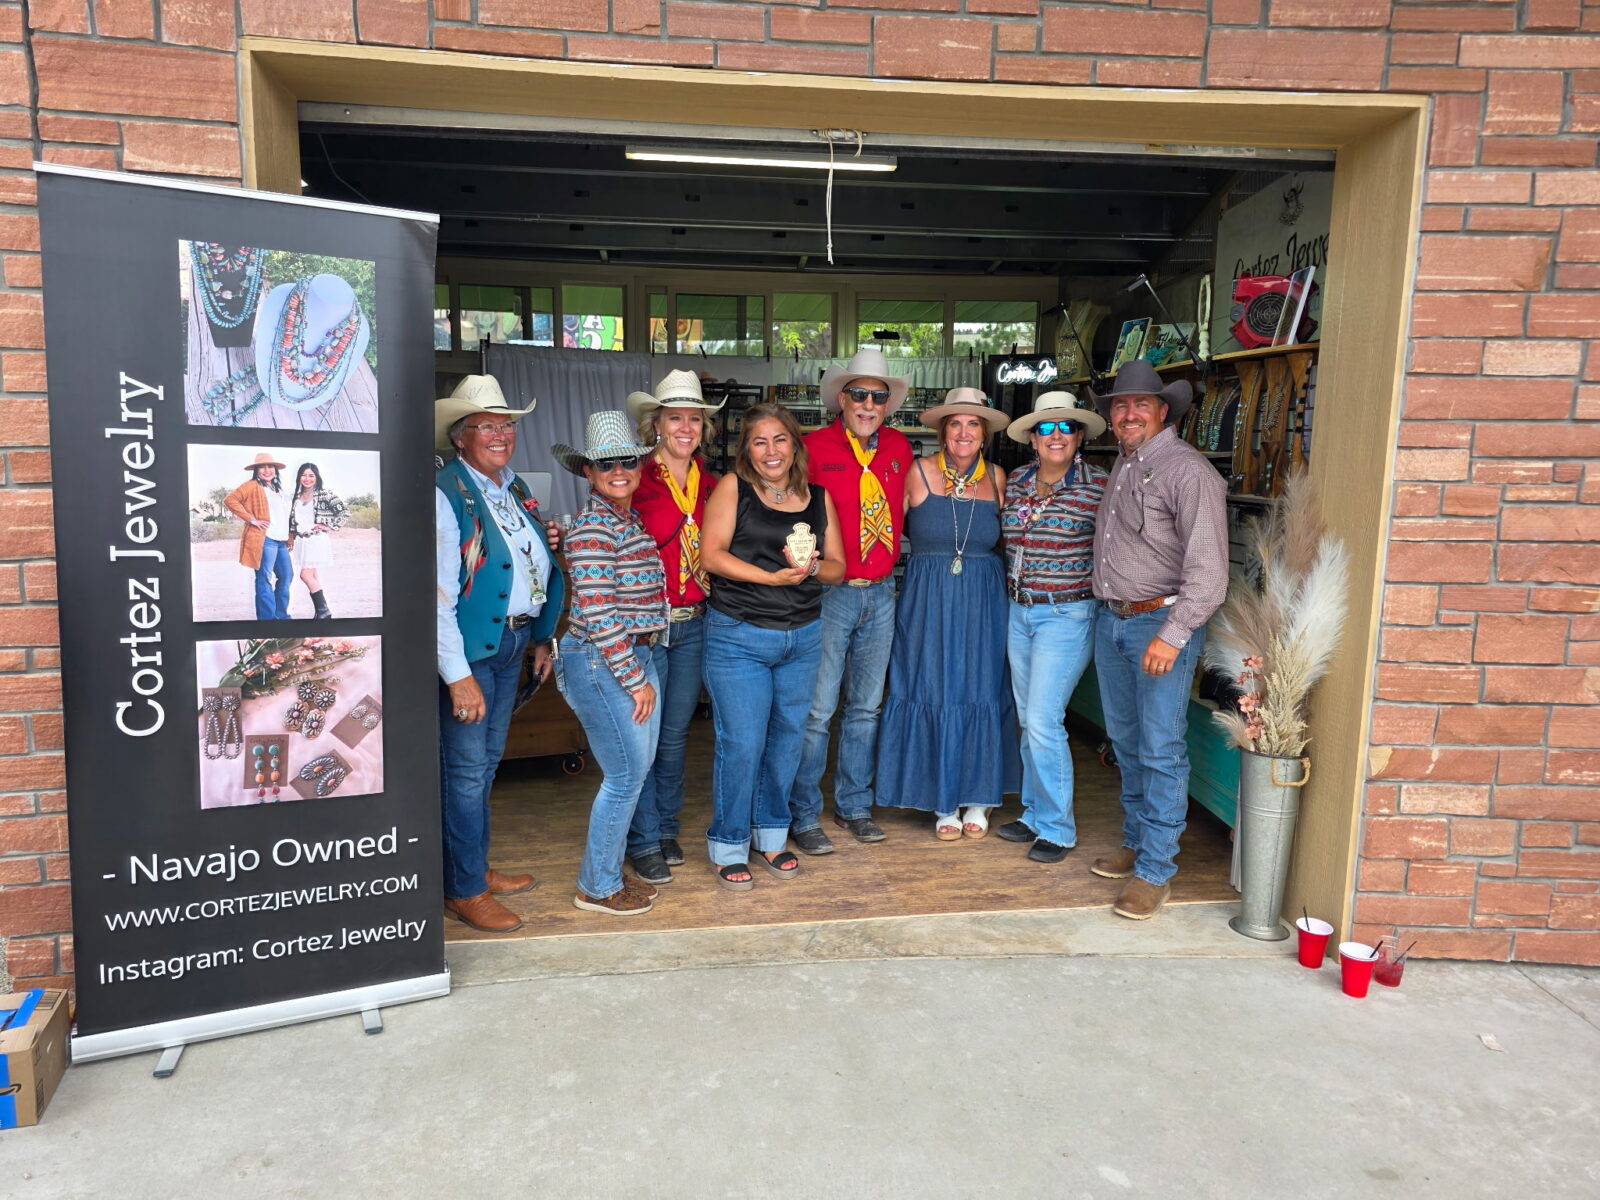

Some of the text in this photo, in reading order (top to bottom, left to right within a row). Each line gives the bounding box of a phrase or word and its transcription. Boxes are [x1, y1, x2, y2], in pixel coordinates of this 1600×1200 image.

[104, 370, 166, 738] Cortez Jewelry
[129, 844, 260, 885] Navajo
[271, 826, 398, 867] Owned
[104, 873, 419, 932] WWW.CORTEZJEWELRY.COM
[99, 918, 427, 985] Instagram: Cortez Jewelry
